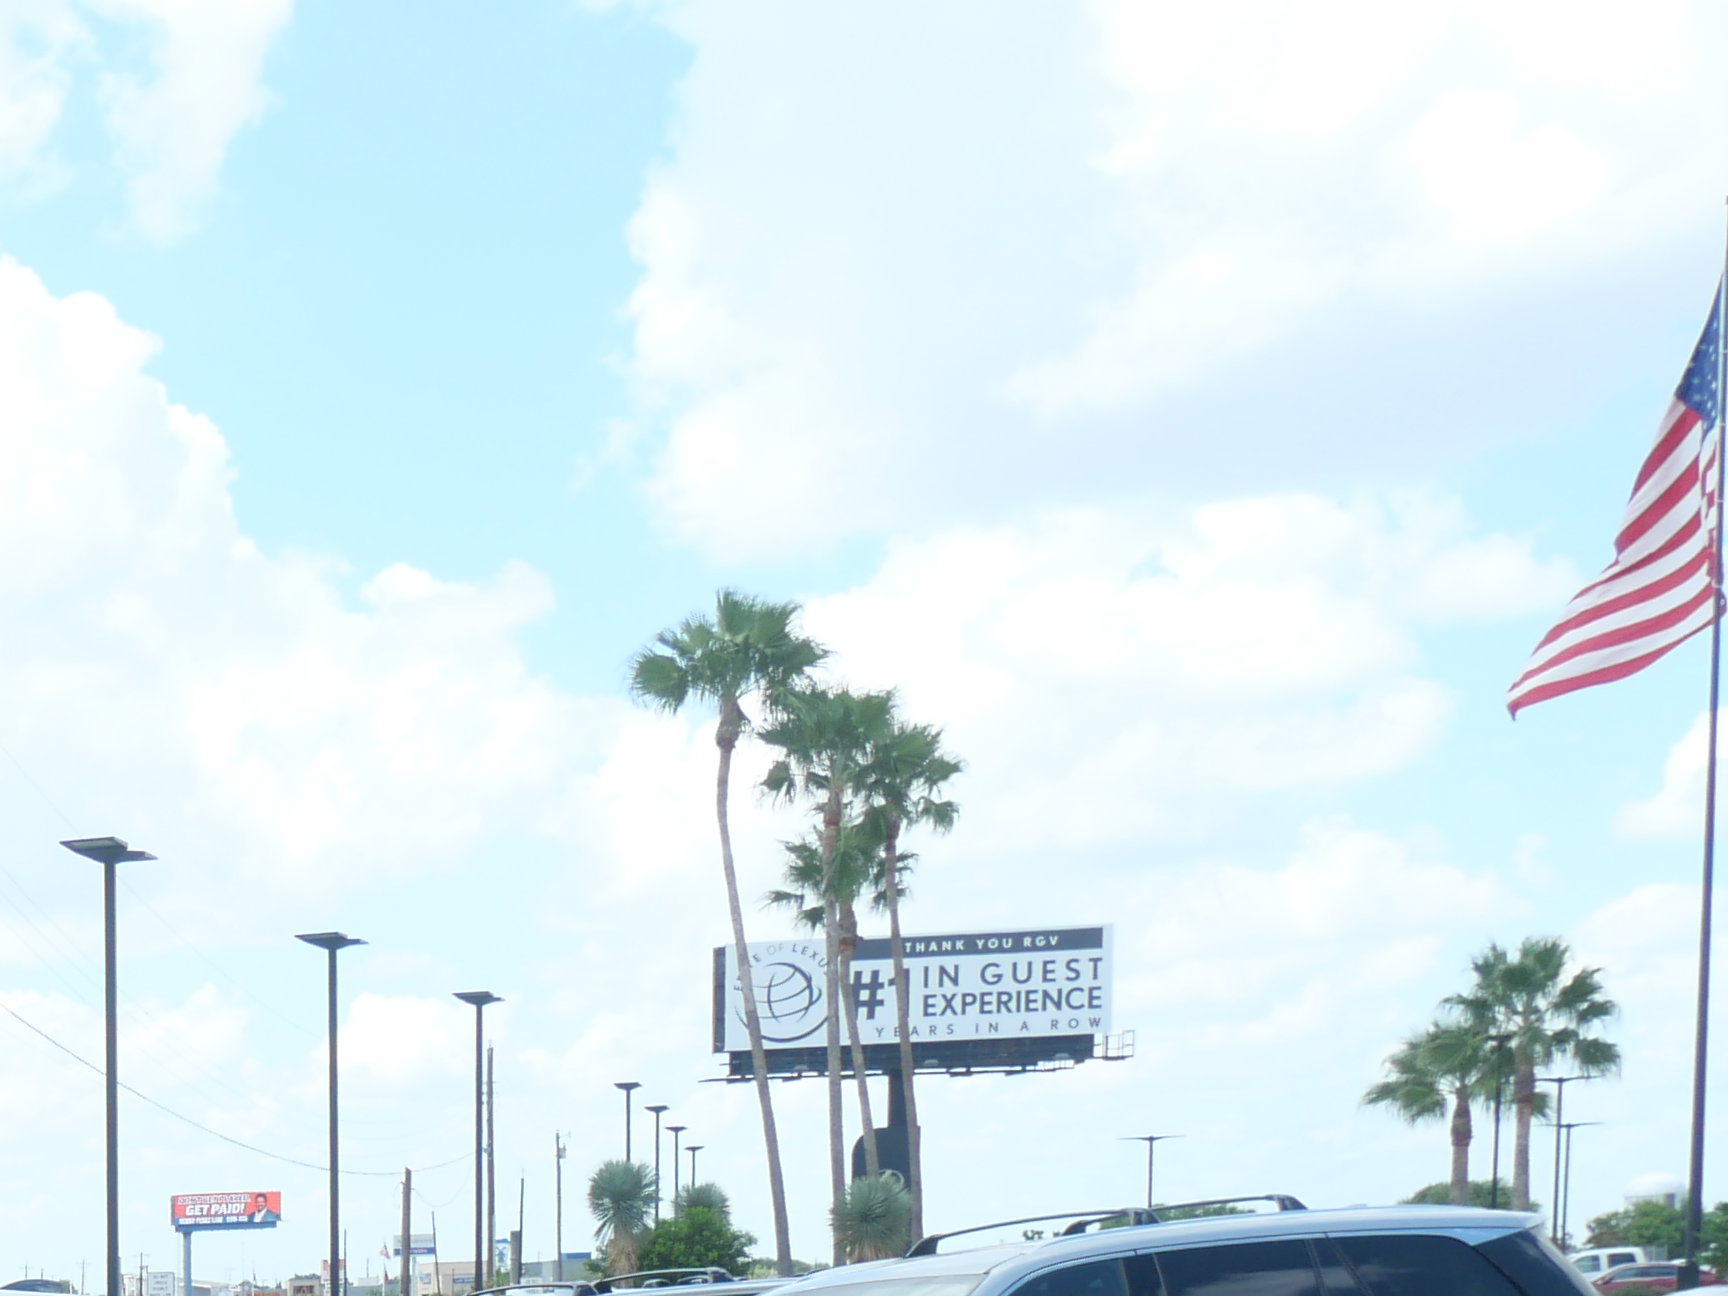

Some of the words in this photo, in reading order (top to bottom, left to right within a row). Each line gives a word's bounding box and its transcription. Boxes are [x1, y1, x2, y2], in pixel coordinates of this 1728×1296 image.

[905, 939, 965, 953] THANK
[976, 937, 1013, 949] YOU
[1023, 935, 1060, 947] RGV
[792, 943, 828, 976] LEXU
[922, 964, 960, 988] IN
[980, 957, 1103, 986] GUEST
[922, 986, 1103, 1017] EXPERIENCE
[875, 1024, 955, 1038] YEARS
[975, 1022, 999, 1034] IN
[1020, 1021, 1030, 1031] A
[1050, 1017, 1102, 1030] ROW
[185, 1204, 210, 1216] GET
[210, 1203, 247, 1215] PAID!
